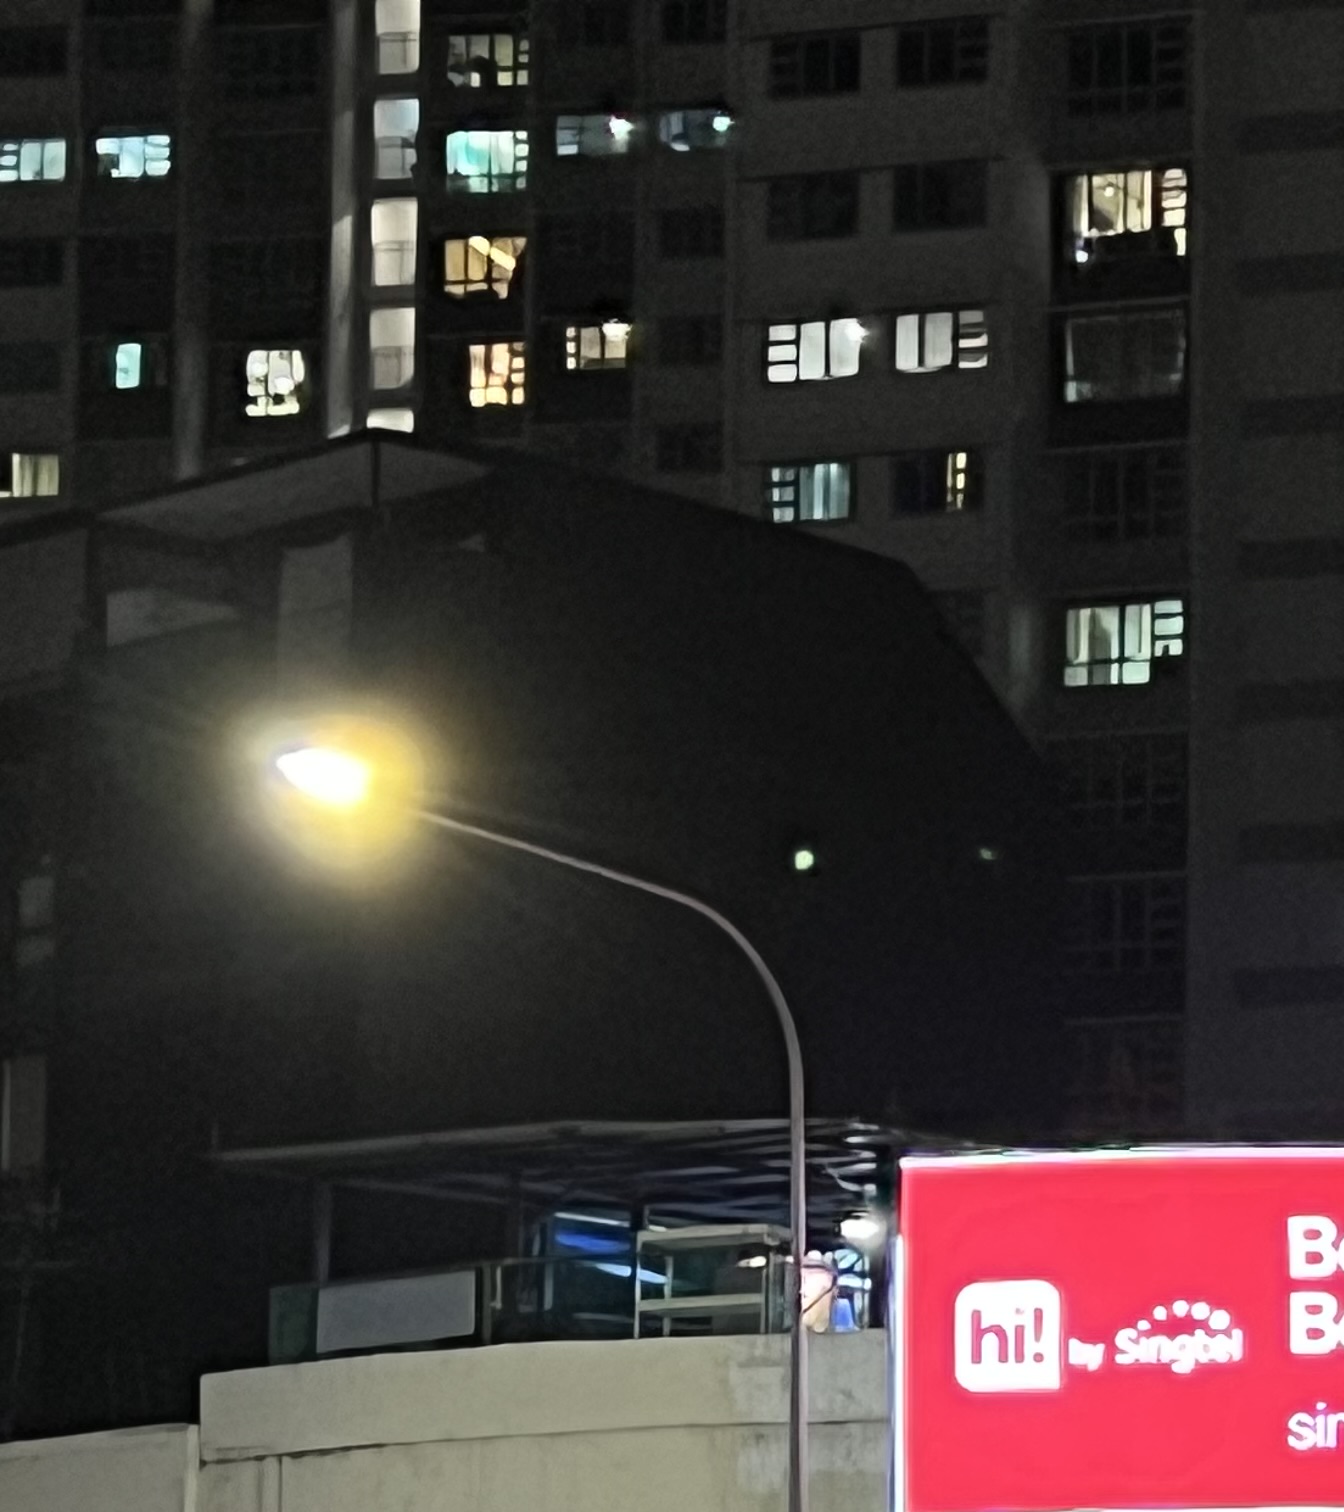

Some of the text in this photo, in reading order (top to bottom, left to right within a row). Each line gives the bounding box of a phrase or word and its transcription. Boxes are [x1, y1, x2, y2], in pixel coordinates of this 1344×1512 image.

[970, 1308, 1243, 1373] hi! by Singtel
